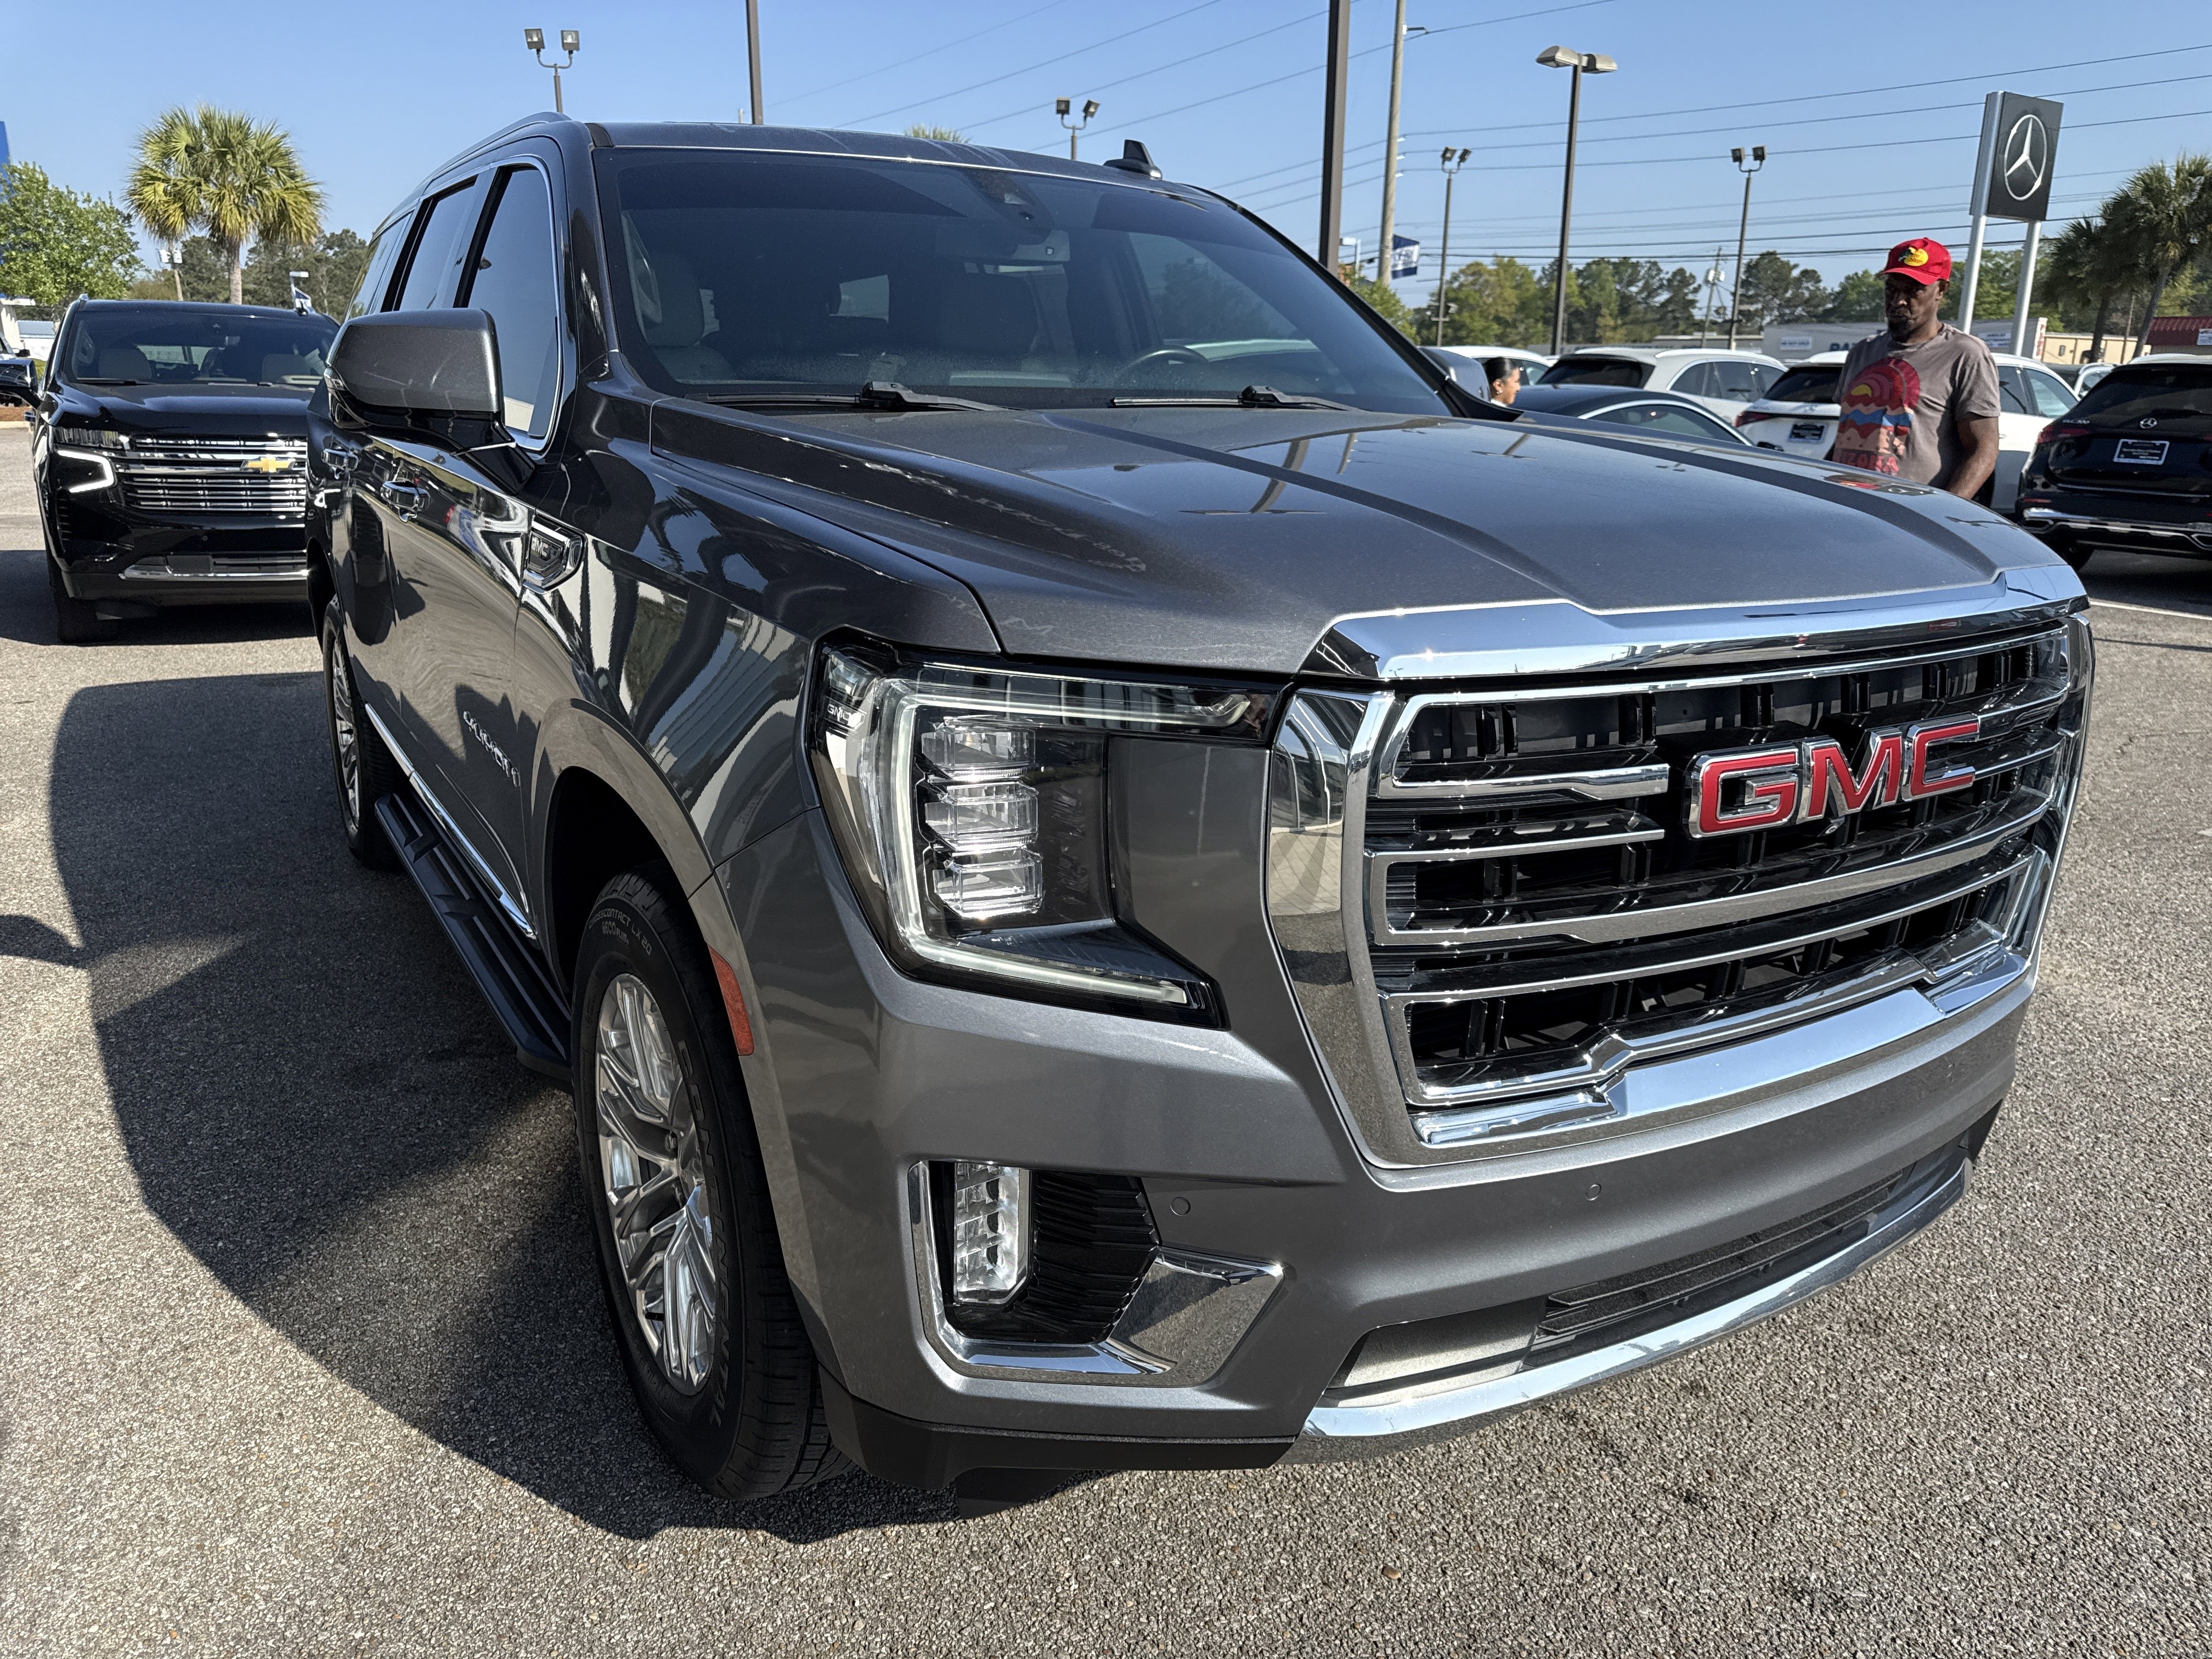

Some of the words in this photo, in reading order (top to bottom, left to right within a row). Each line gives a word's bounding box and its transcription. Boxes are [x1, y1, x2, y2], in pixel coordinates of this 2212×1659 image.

[531, 536, 549, 558] GMC
[827, 703, 851, 721] GMC
[463, 710, 521, 788] YUKON
[1688, 712, 1980, 839] GMC
